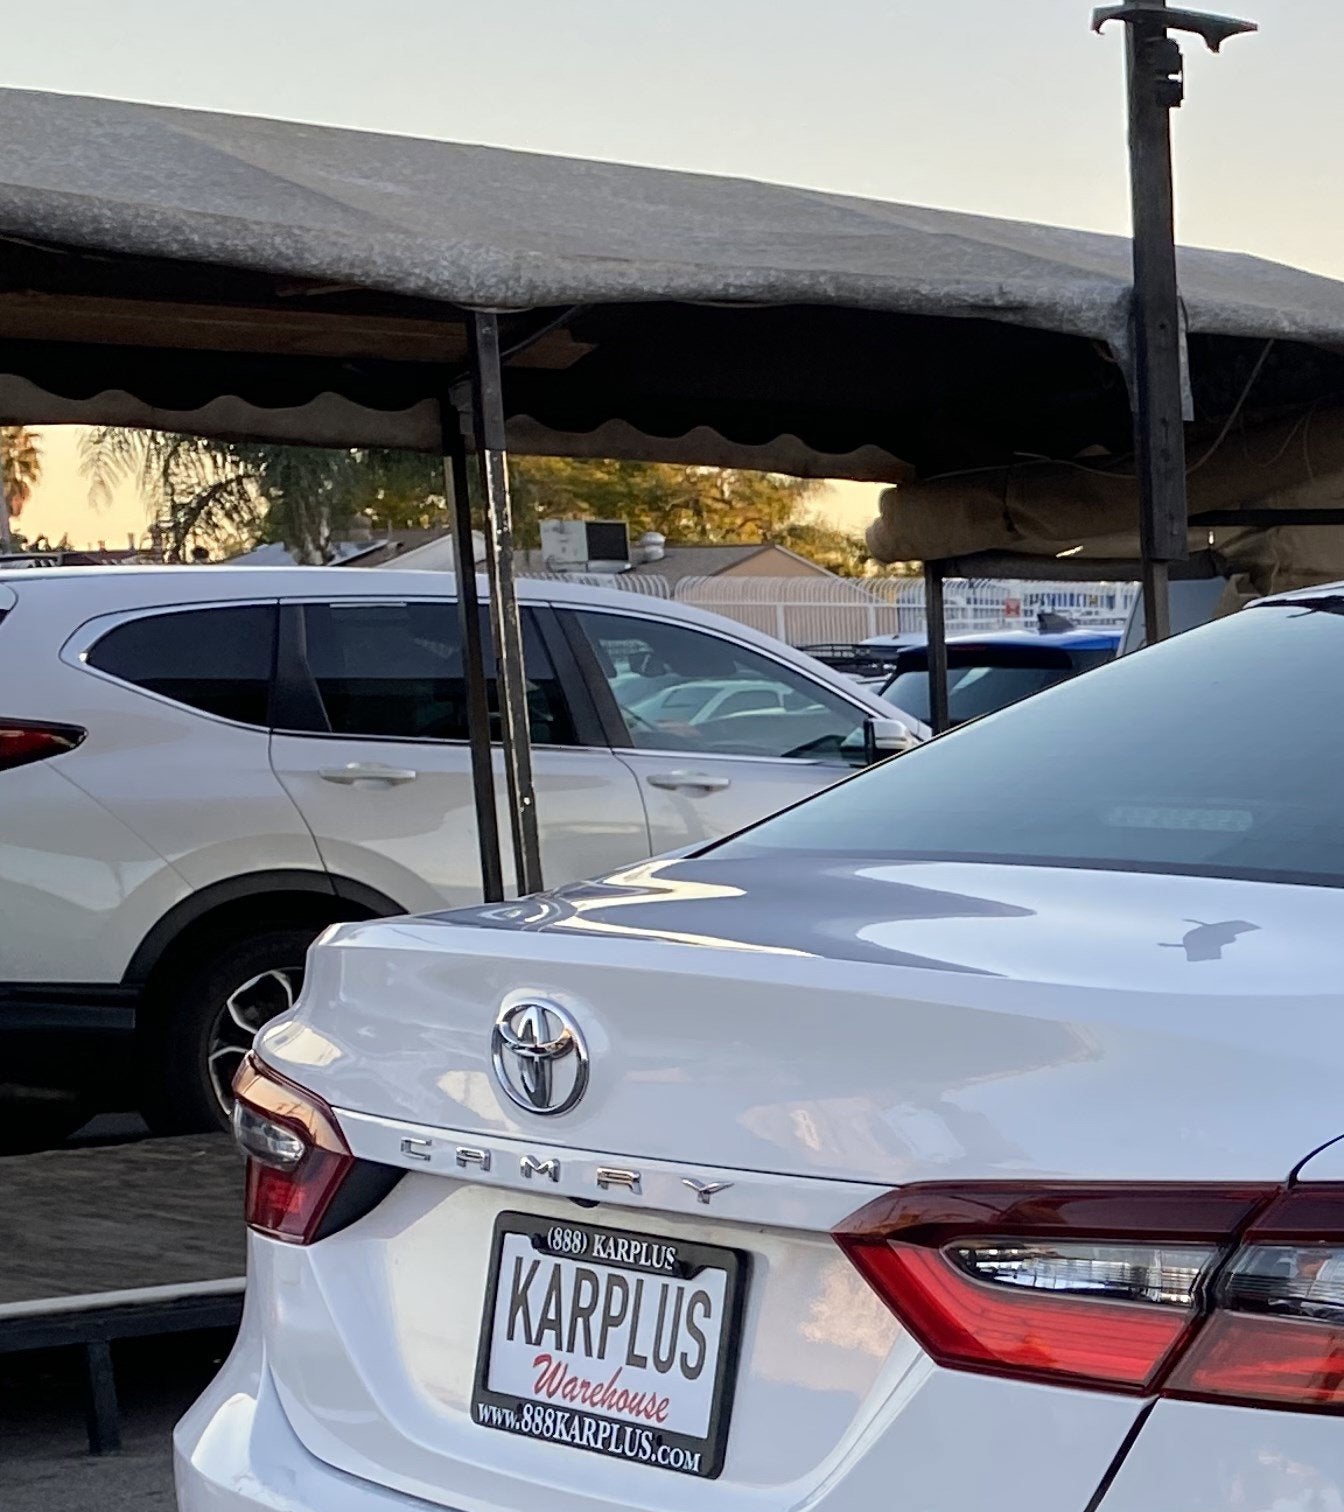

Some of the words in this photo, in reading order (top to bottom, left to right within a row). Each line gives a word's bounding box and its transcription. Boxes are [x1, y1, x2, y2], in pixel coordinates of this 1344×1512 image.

[400, 1137, 735, 1205] CAMRY
[547, 1226, 588, 1254] (888)
[592, 1233, 677, 1270] KARPLUS
[506, 1255, 712, 1380] KARPLUS
[532, 1353, 670, 1424] Warehouse
